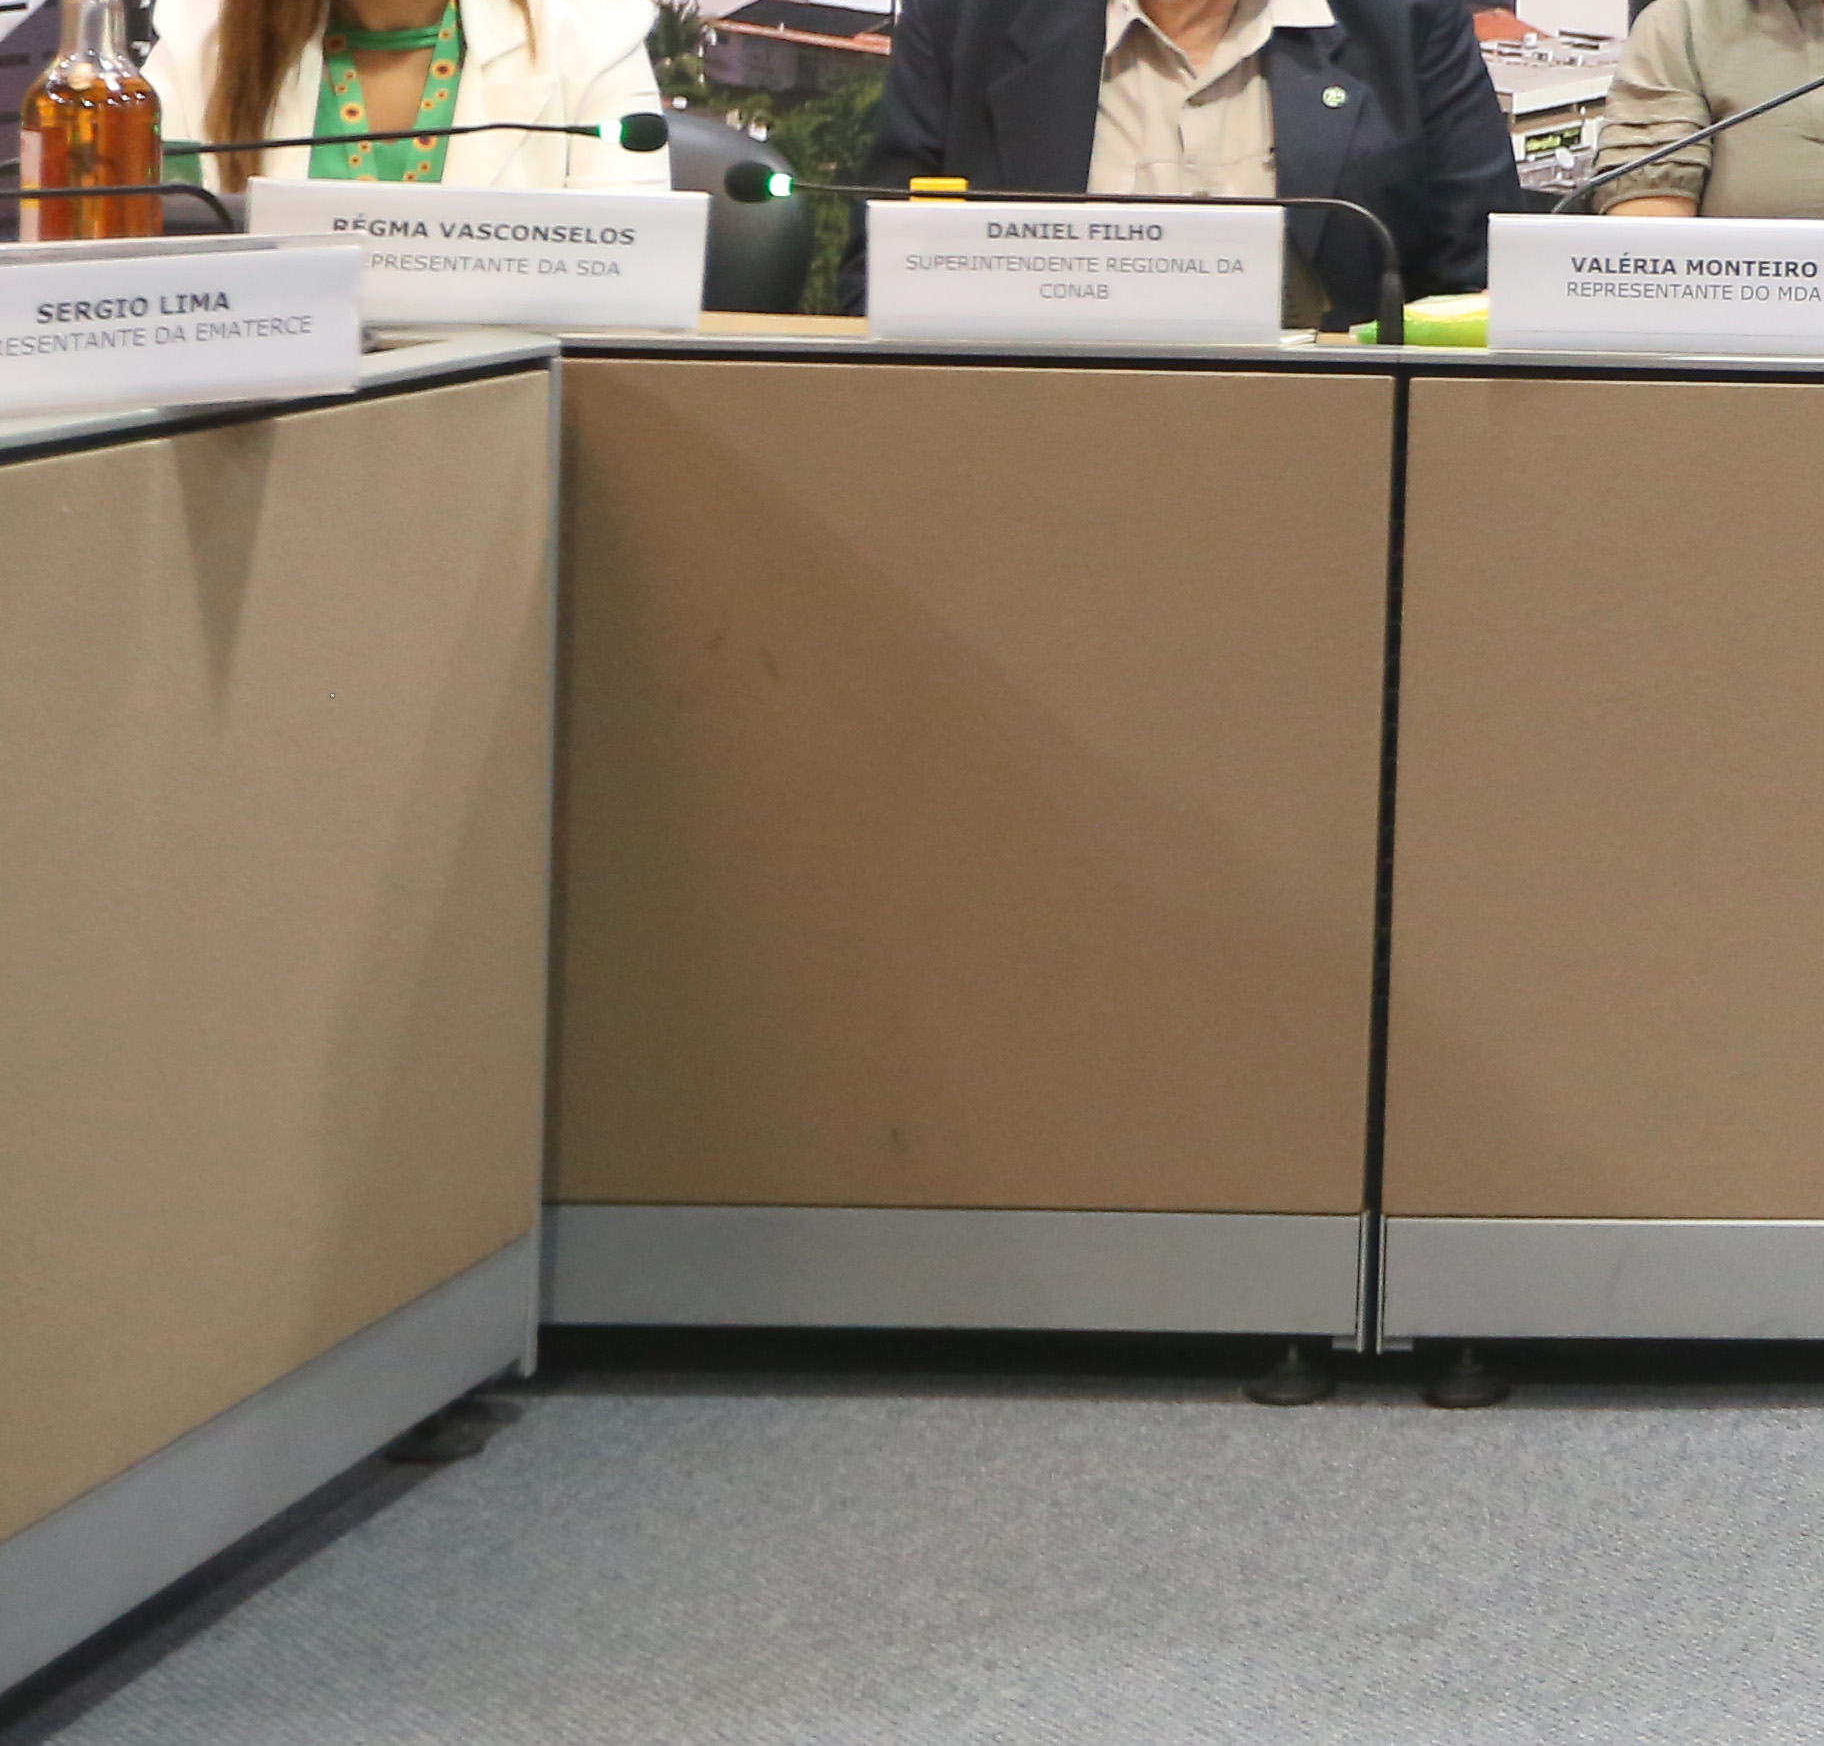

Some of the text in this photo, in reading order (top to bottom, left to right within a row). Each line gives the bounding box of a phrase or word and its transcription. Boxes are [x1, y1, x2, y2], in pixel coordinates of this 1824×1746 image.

[440, 222, 635, 245] VASCONSELOS
[987, 222, 1163, 241] DANIEL FILHO
[365, 253, 621, 276] PRESENTANTE DA SDA
[906, 254, 1244, 274] SUPERINTENDENTE REGIONAL DA
[1571, 252, 1818, 278] VALÉRIA MONTEIRO
[1039, 283, 1109, 299] CONAB
[1567, 281, 1821, 302] REPRESENTANTE DO MDA
[37, 292, 230, 324] SERGIO LIMA
[155, 325, 186, 345] DA
[196, 315, 313, 342] EMATERCE
